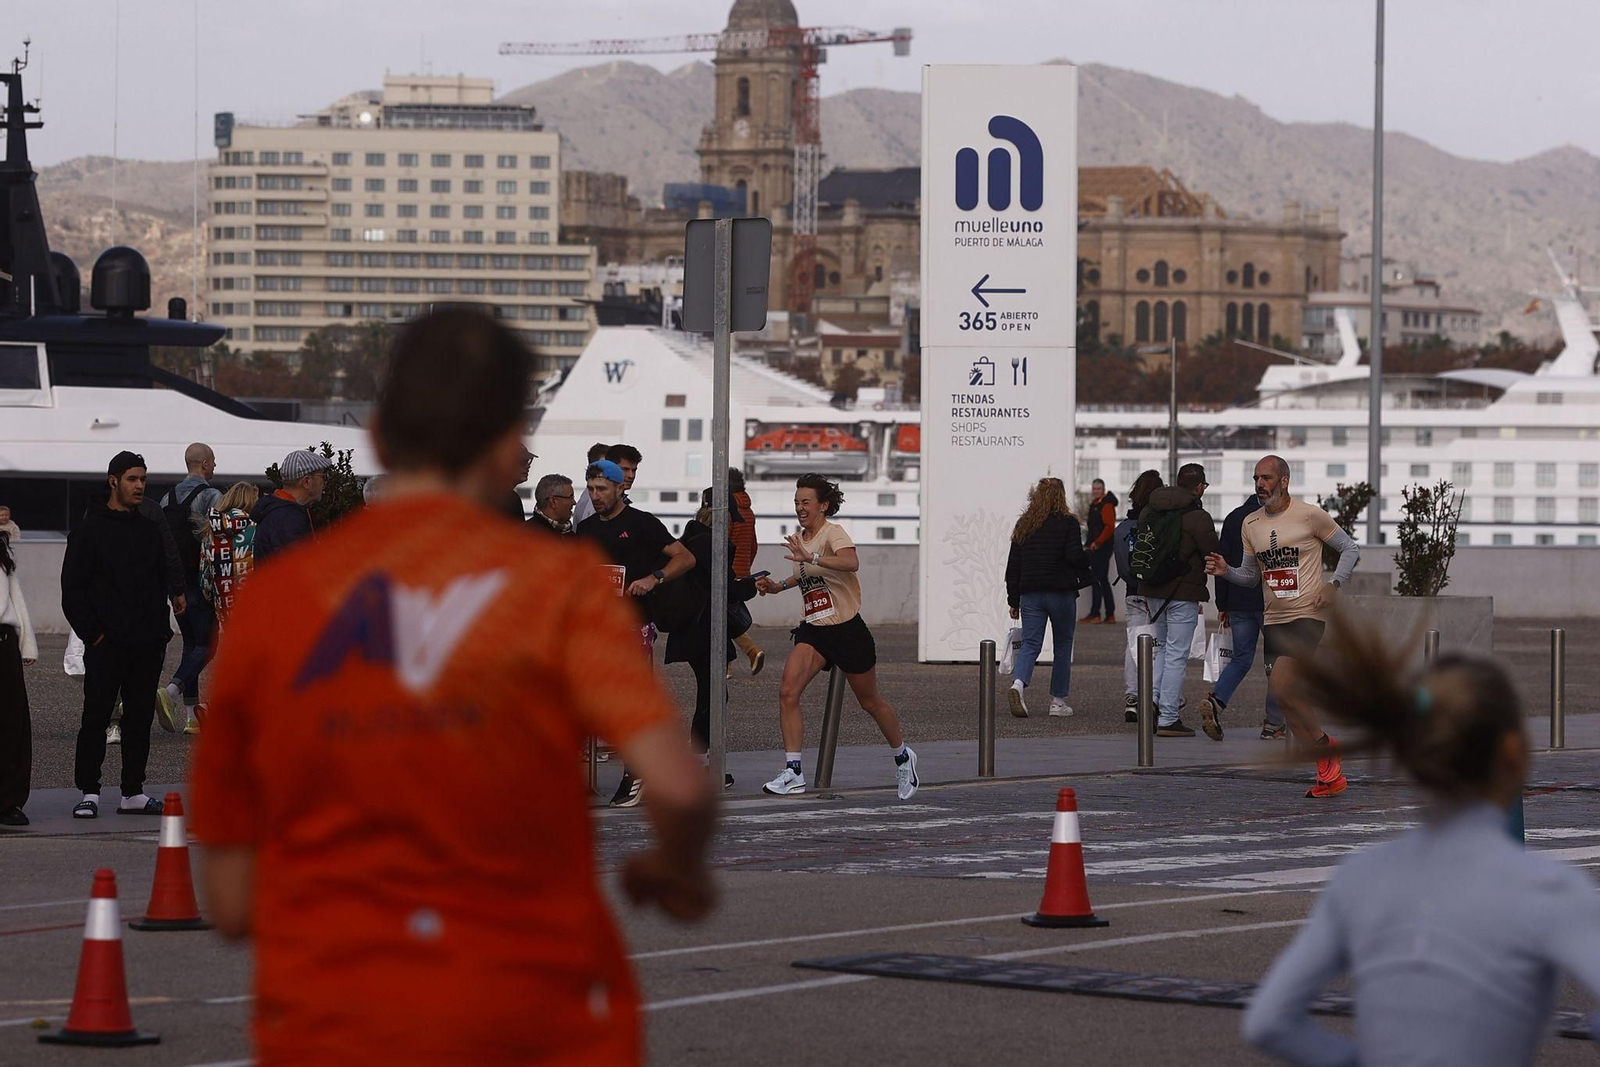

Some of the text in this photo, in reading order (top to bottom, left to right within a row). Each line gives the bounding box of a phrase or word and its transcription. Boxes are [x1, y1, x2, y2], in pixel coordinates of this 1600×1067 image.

[955, 217, 1043, 233] muelleuno
[954, 235, 1043, 247] PUERTO DE MÁLAGA
[1000, 312, 1039, 320] ABIERTO
[959, 312, 997, 331] 365
[1001, 323, 1031, 331] OPEN
[951, 394, 995, 404] TIENDAS
[951, 408, 1030, 418] RESTAURANTES
[951, 422, 987, 433] SHOPS
[951, 436, 1025, 446] RESTAURANTS
[812, 597, 828, 608] 329
